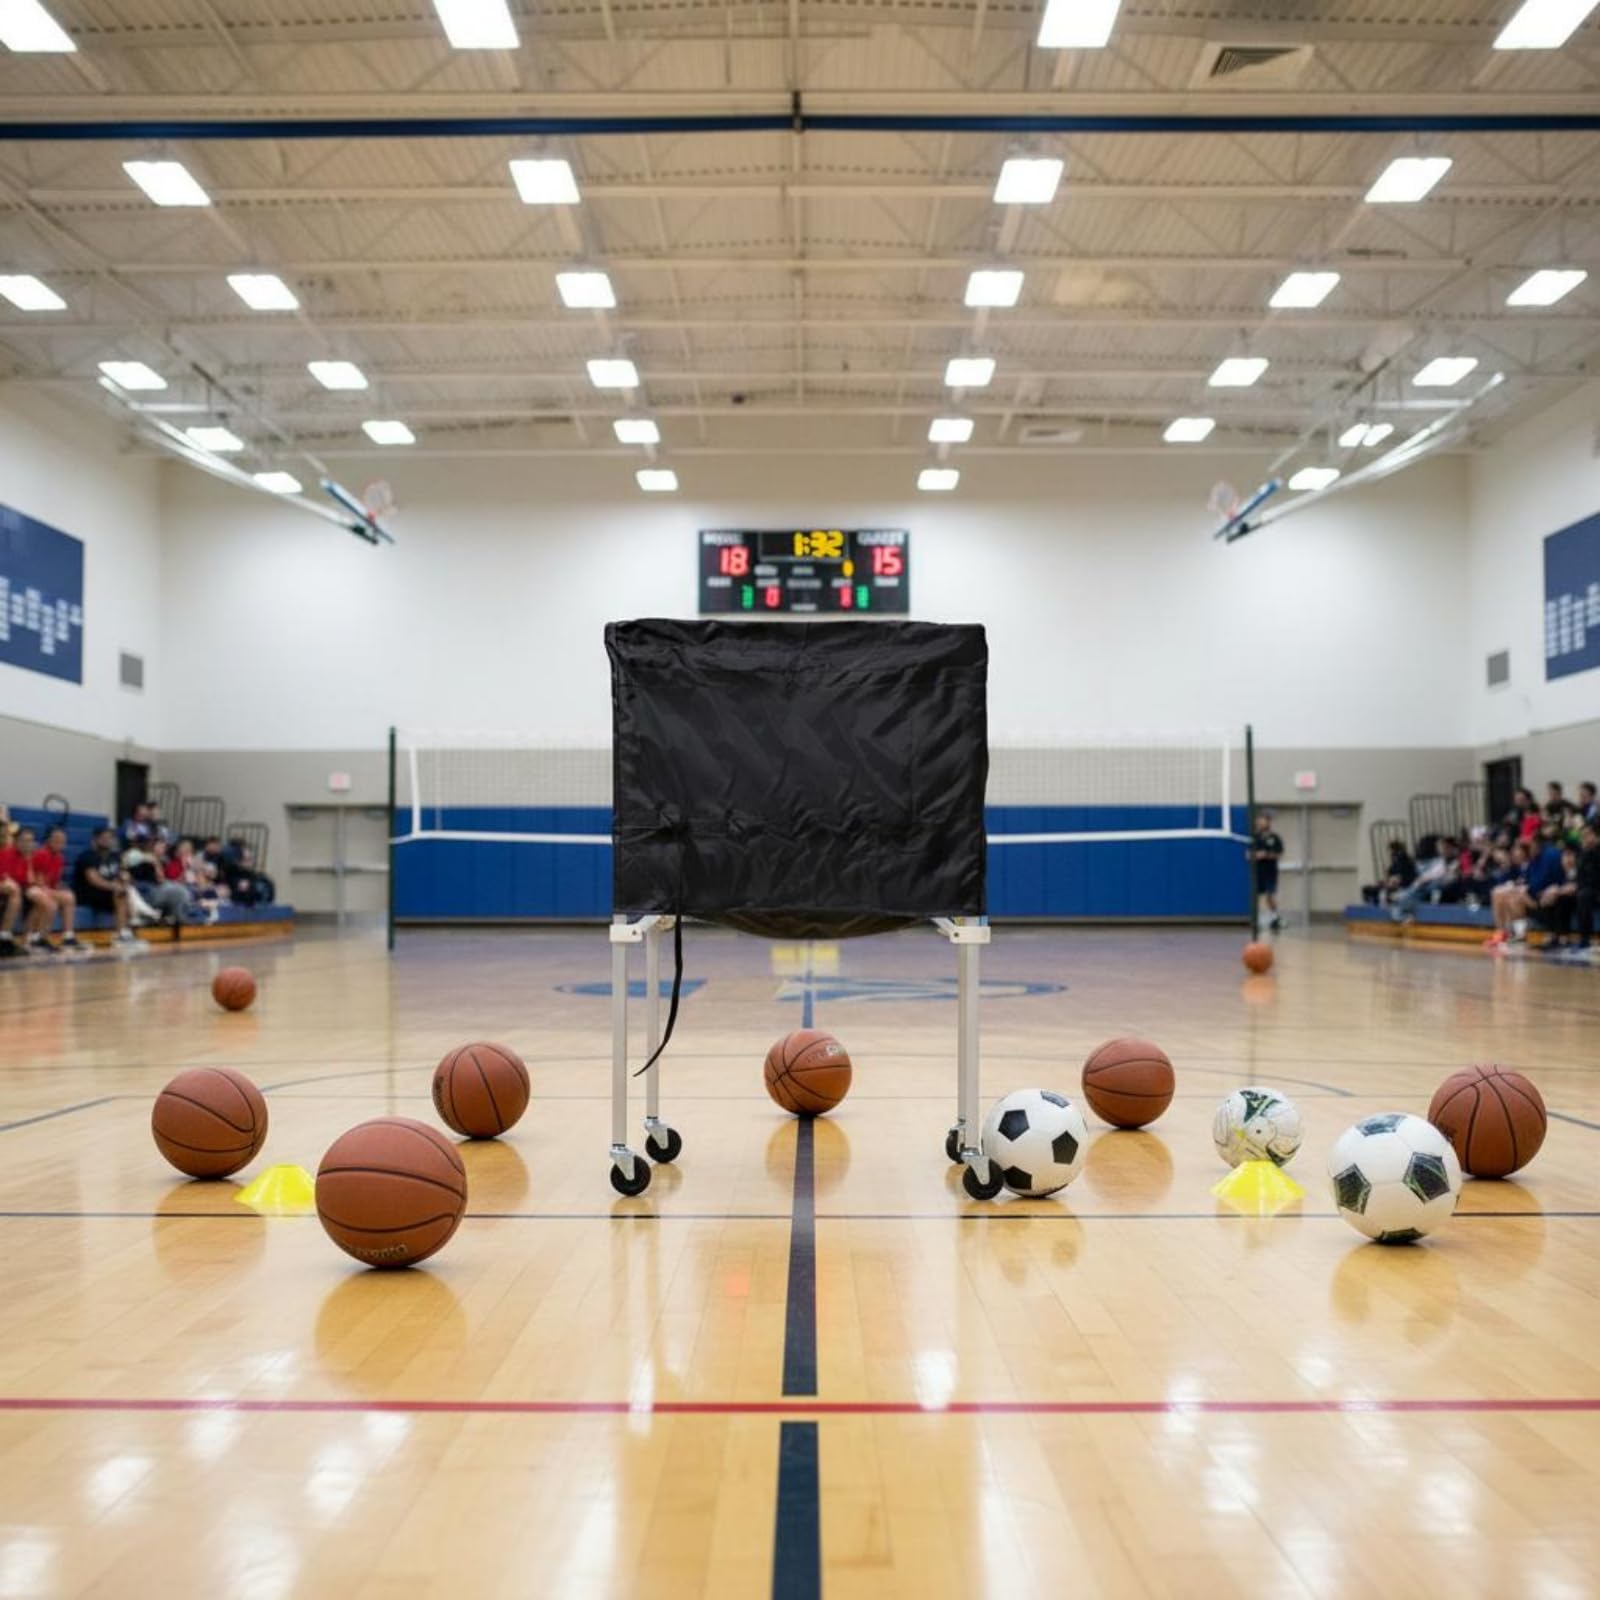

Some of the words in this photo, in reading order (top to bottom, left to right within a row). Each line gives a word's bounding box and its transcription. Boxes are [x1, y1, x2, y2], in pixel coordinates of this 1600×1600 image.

[793, 530, 844, 557] 1:32
[720, 546, 749, 576] 18
[872, 546, 903, 576] 15
